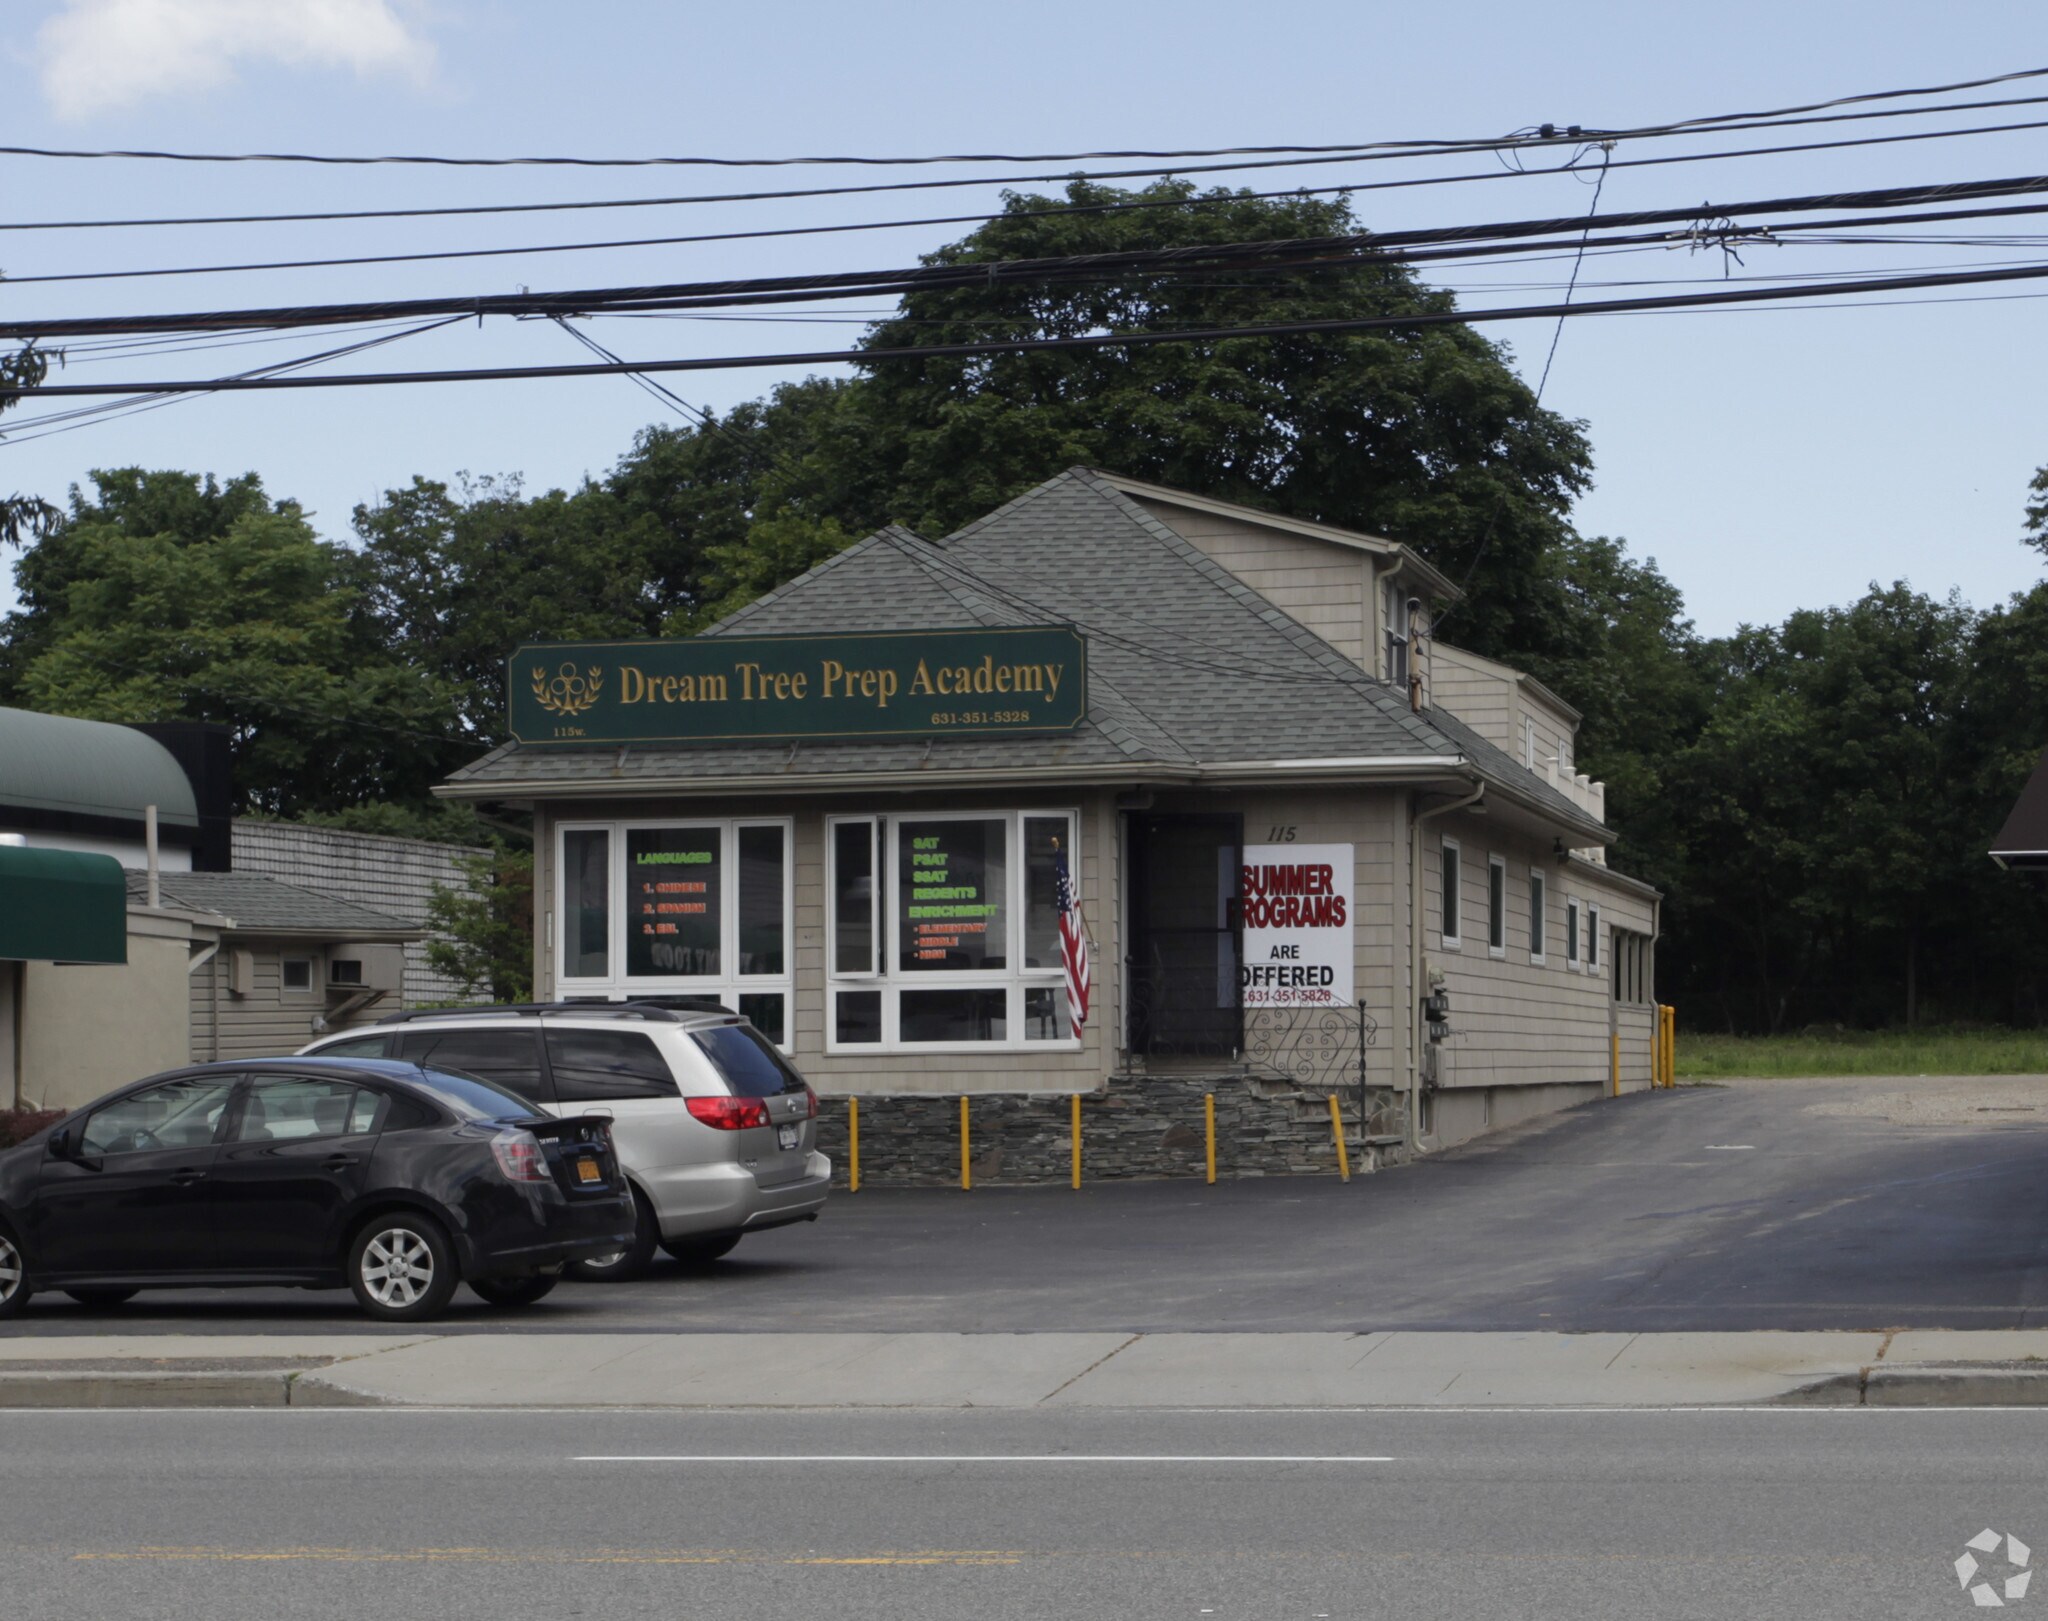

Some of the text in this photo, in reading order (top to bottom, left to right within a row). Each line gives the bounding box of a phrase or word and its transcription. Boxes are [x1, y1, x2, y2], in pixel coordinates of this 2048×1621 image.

[619, 656, 1064, 708] Dream Tree Prep Academy
[931, 711, 1030, 725] 631-351-5328
[1267, 826, 1296, 842] 115
[913, 837, 939, 849] SAT
[637, 852, 712, 864] LANGUAGES
[913, 854, 948, 866] PSAT
[913, 871, 948, 882] SSAT
[1242, 864, 1334, 896] SUMMER
[913, 887, 976, 899] REGENTS
[909, 905, 997, 918] ENRICHMENT
[919, 923, 987, 934] ELEMENTARY
[1270, 945, 1300, 959] ARE
